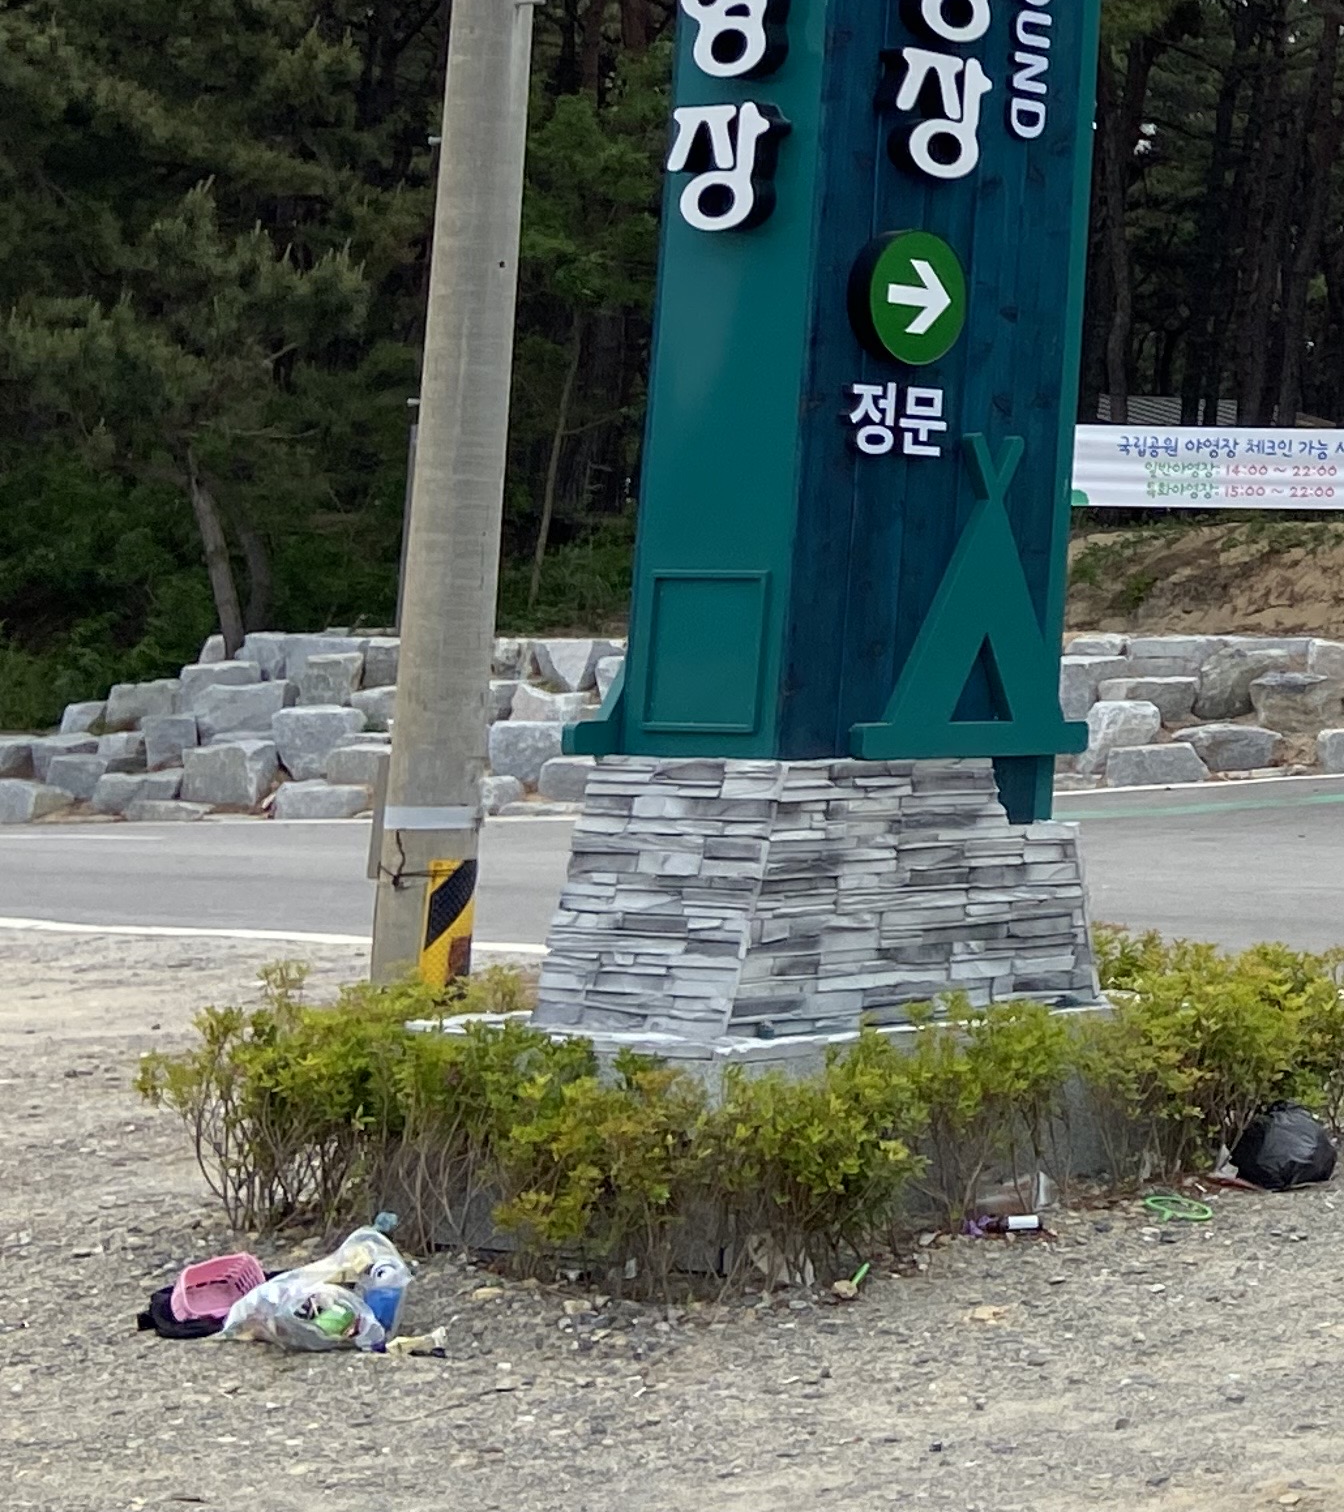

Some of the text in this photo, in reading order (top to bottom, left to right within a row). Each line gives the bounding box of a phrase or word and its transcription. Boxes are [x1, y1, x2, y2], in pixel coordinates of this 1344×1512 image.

[849, 382, 948, 458] 정문
[1117, 435, 1179, 458] 국립공원
[1185, 437, 1240, 459] 야영장
[1245, 438, 1293, 458] 체크인
[1298, 439, 1329, 460] 가능
[1225, 464, 1268, 476] 14:00
[1292, 465, 1337, 476] 22:00
[1224, 485, 1266, 498] 15:00
[1289, 486, 1335, 498] 22:00
